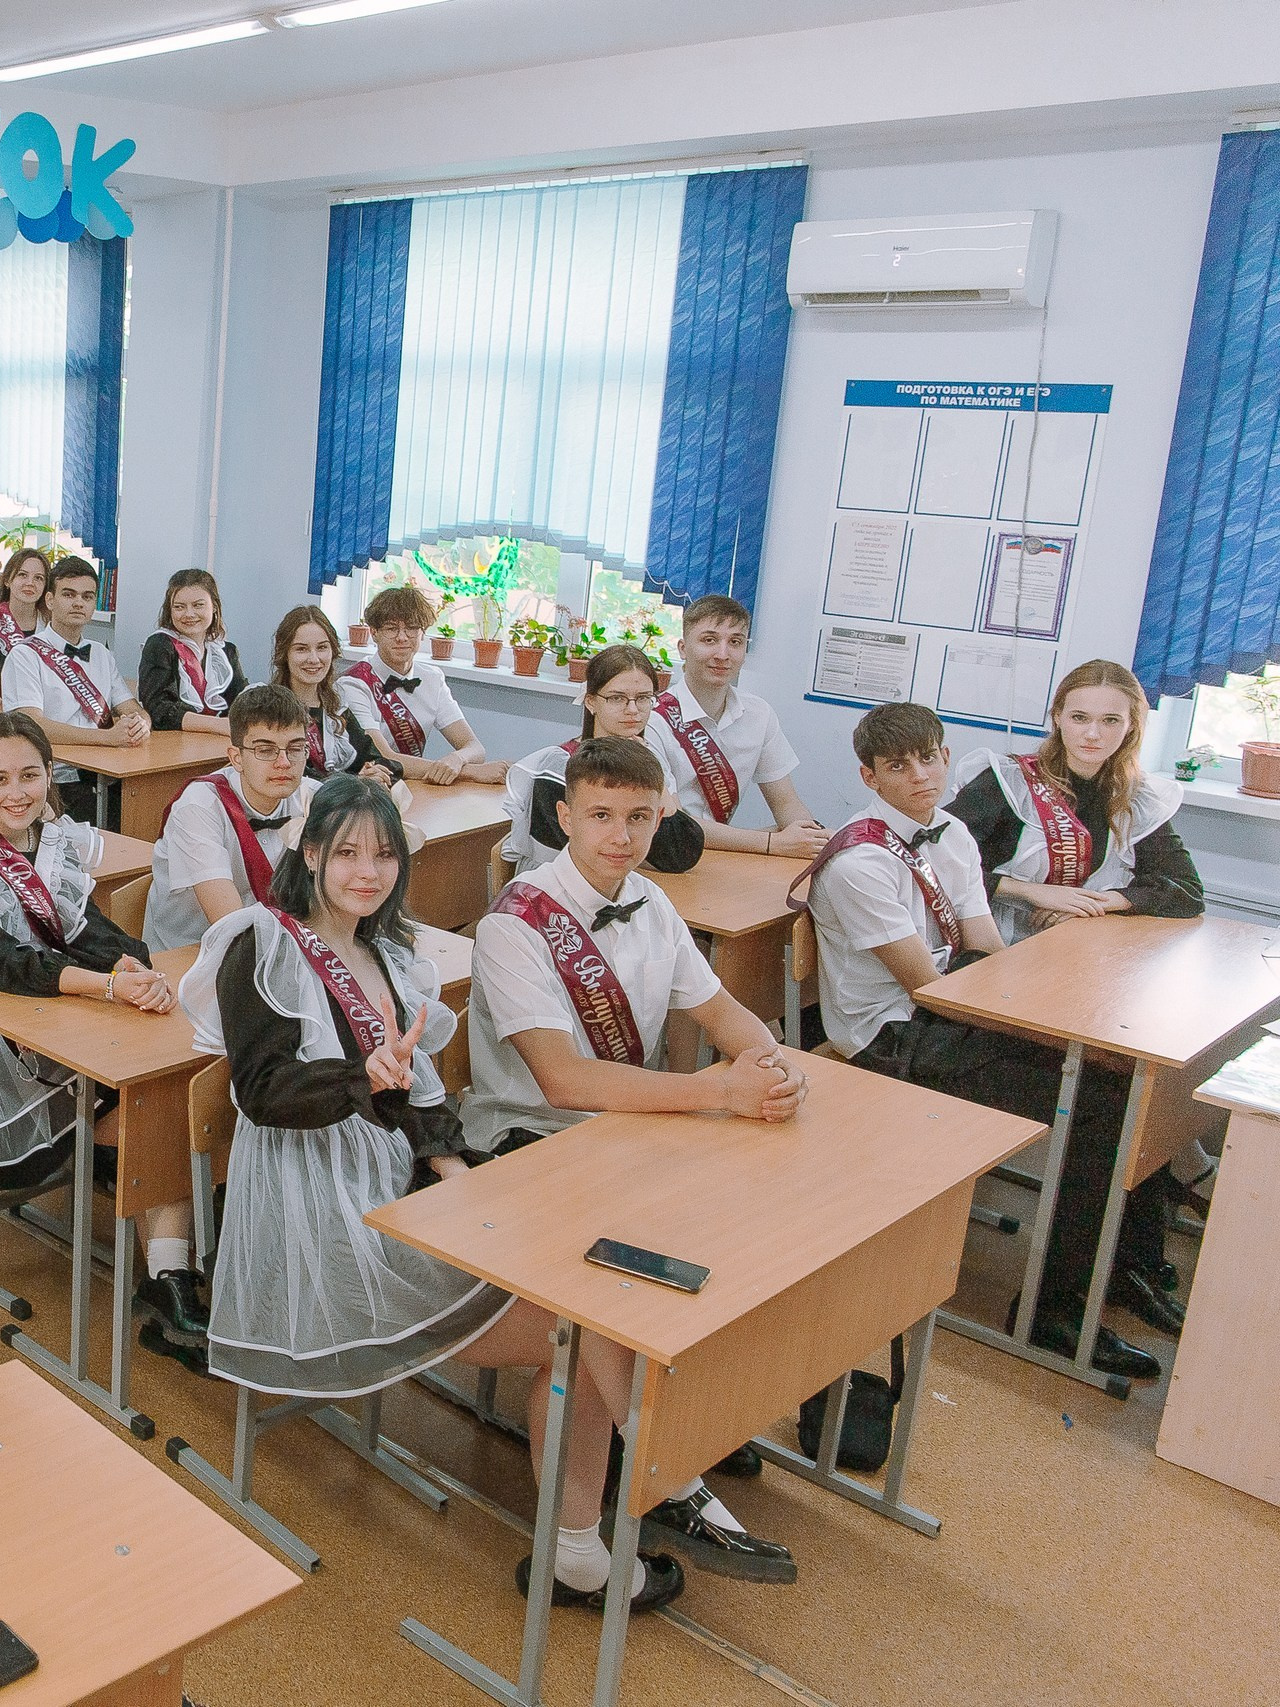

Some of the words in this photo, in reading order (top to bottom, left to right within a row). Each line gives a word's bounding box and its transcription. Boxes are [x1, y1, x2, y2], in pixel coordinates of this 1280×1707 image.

[896, 384, 974, 396] ПОДГОТОВКА
[976, 386, 985, 395] К
[988, 386, 1012, 396] ОГЭ
[1014, 387, 1024, 396] И
[920, 396, 937, 405] ПО
[939, 396, 1021, 407] МАТЕМАТИКЕ
[359, 1027, 373, 1051] СОШ
